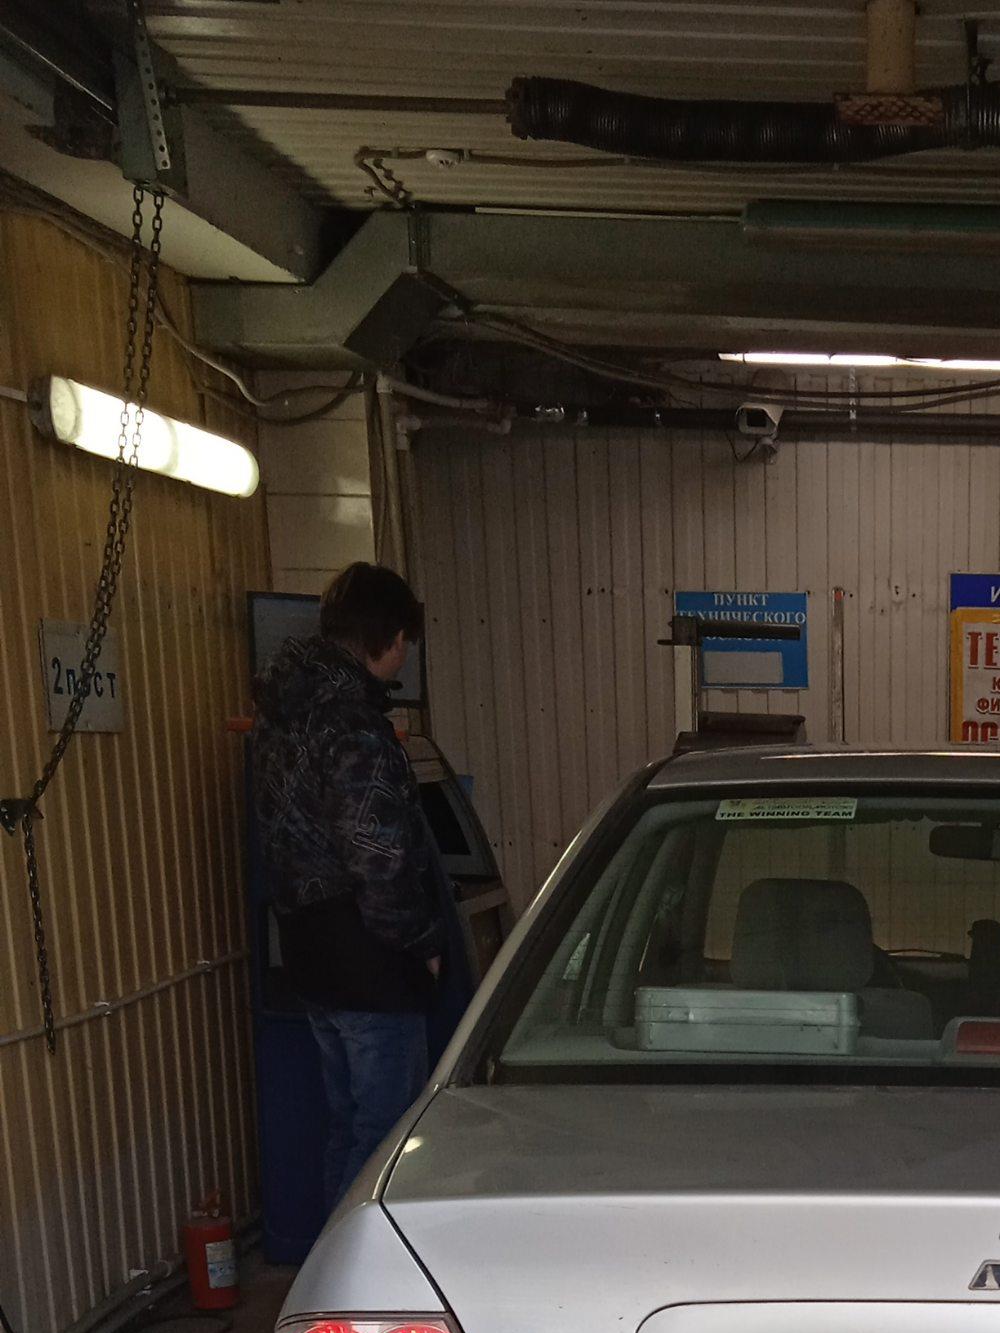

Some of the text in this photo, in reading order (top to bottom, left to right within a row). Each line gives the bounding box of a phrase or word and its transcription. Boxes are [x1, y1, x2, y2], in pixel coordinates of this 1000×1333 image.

[714, 593, 769, 606] ПУНКТ
[719, 810, 853, 819] THE WINNING TEAM
